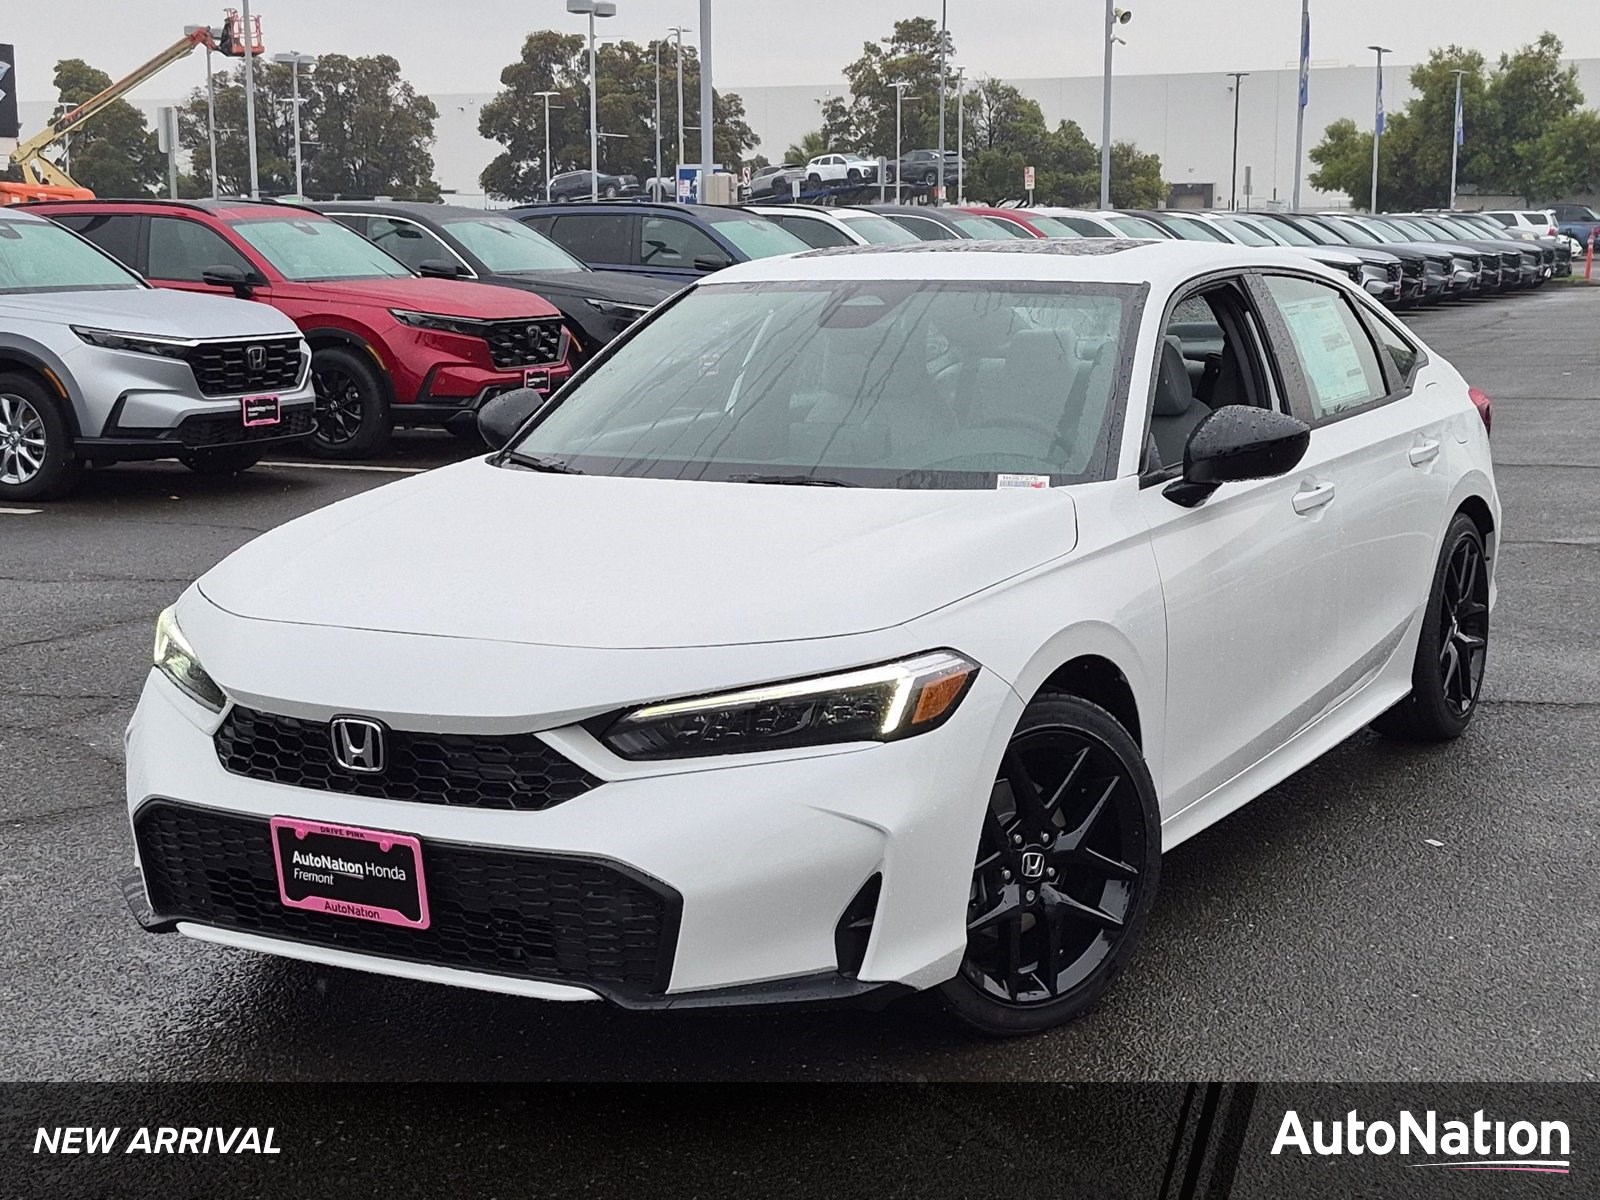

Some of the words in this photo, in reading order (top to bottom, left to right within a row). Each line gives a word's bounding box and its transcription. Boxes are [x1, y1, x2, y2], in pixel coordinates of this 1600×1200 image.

[292, 851, 364, 875] AutoNation
[365, 862, 406, 881] Honda
[294, 868, 334, 886] Fremont
[324, 901, 380, 920] AutoNation
